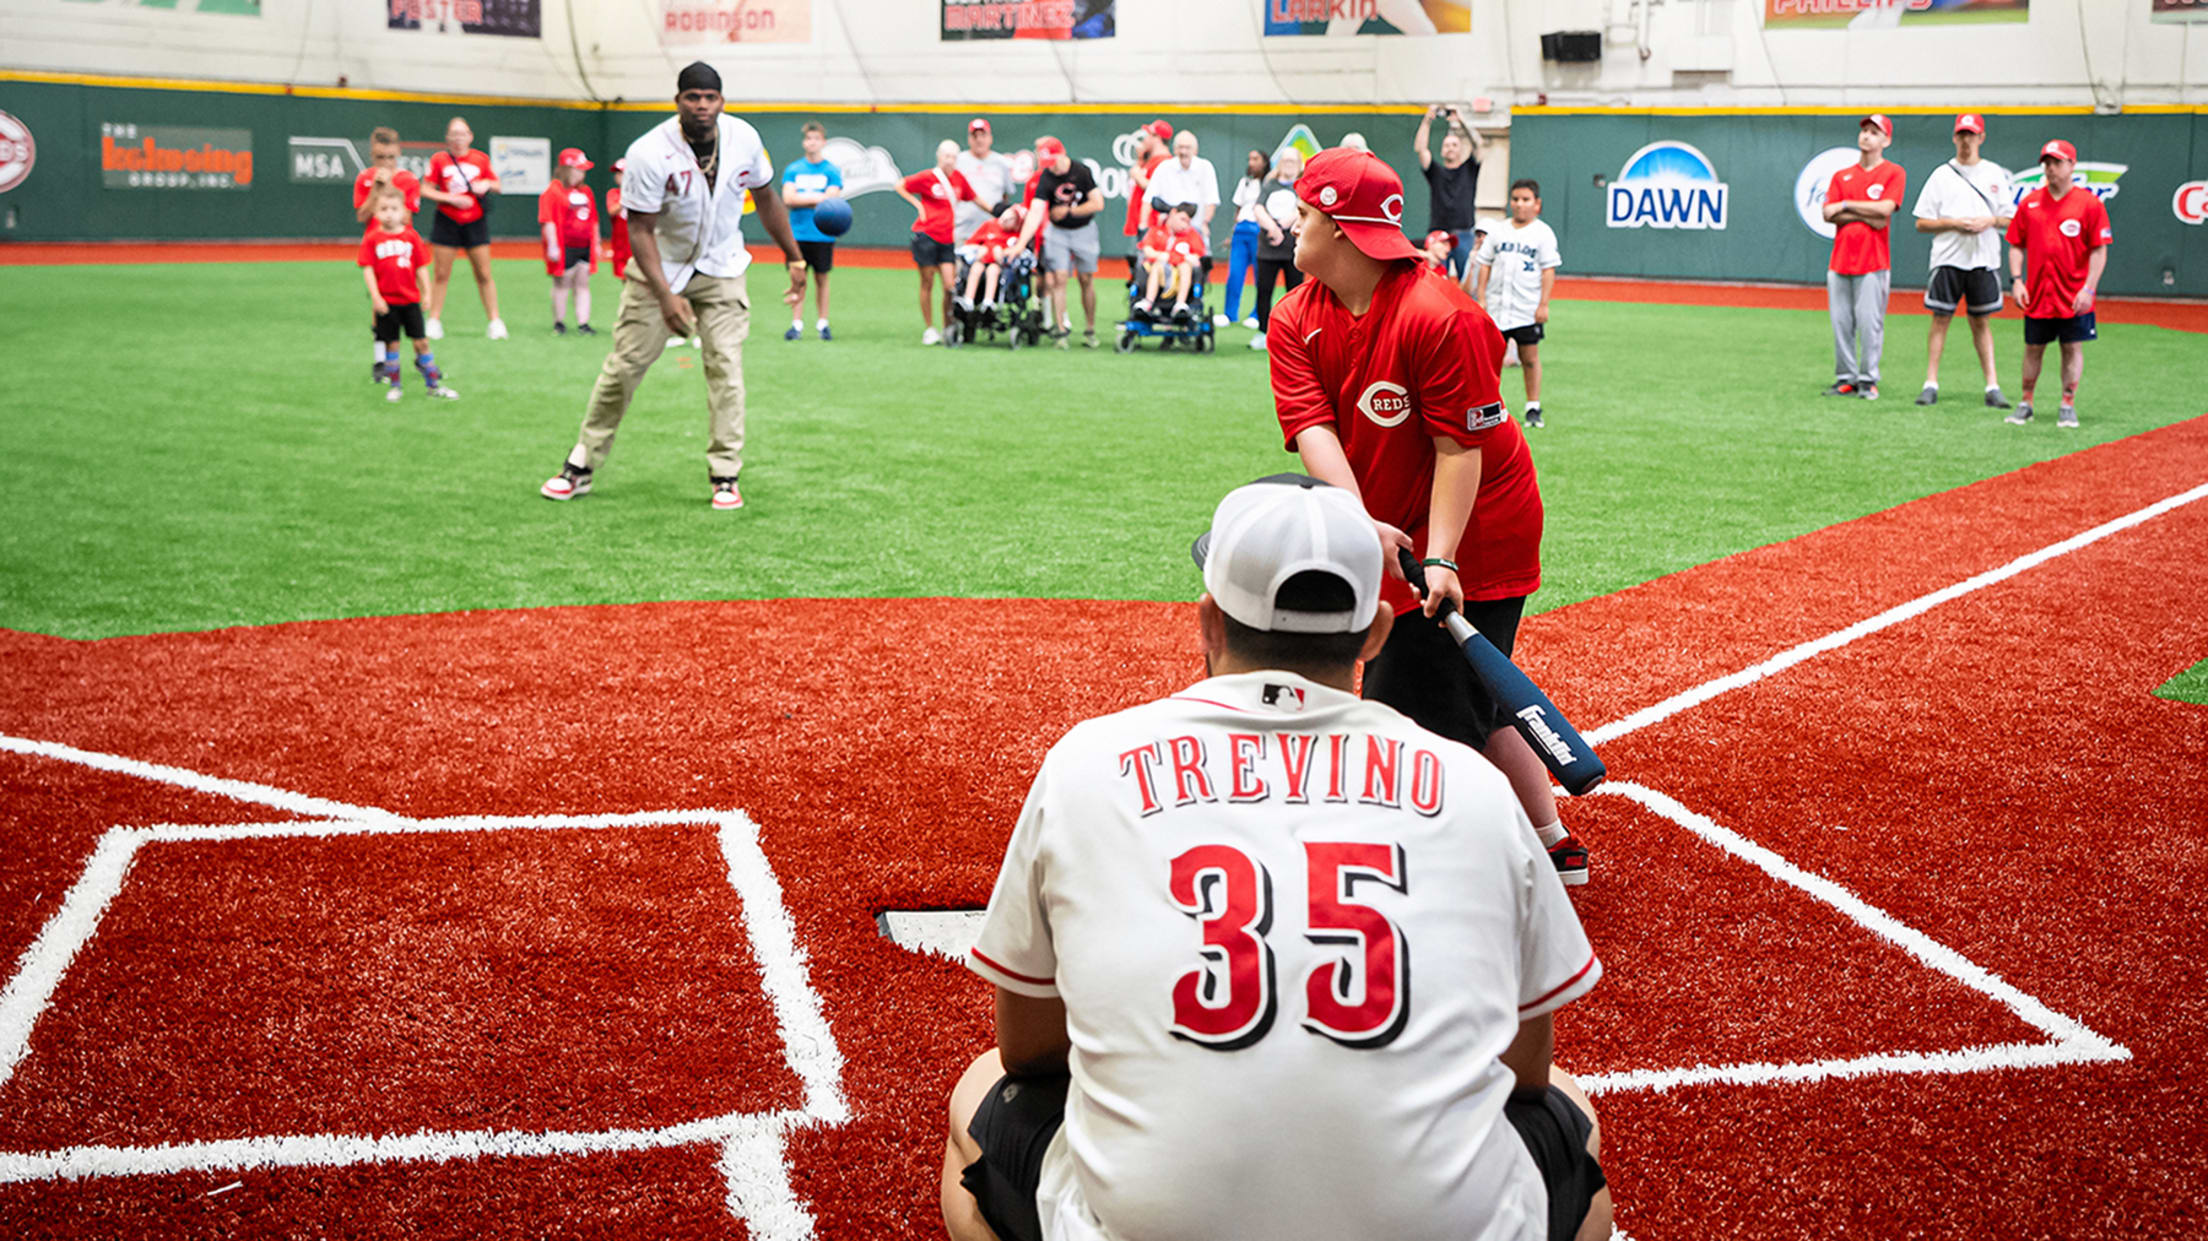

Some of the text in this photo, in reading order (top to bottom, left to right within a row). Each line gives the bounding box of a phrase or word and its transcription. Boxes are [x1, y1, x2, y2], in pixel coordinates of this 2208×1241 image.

[665, 10, 775, 32] ROBINSON
[944, 1, 1076, 31] MARTINEZ
[1272, 0, 1378, 22] LARKIN
[295, 153, 345, 178] MSA
[665, 169, 702, 197] 47
[1612, 187, 1723, 223] DAWN
[1372, 394, 1410, 412] REDS
[1515, 704, 1577, 767] Franklin
[1119, 732, 1445, 818] TREVINO
[1167, 841, 1412, 1052] 35
